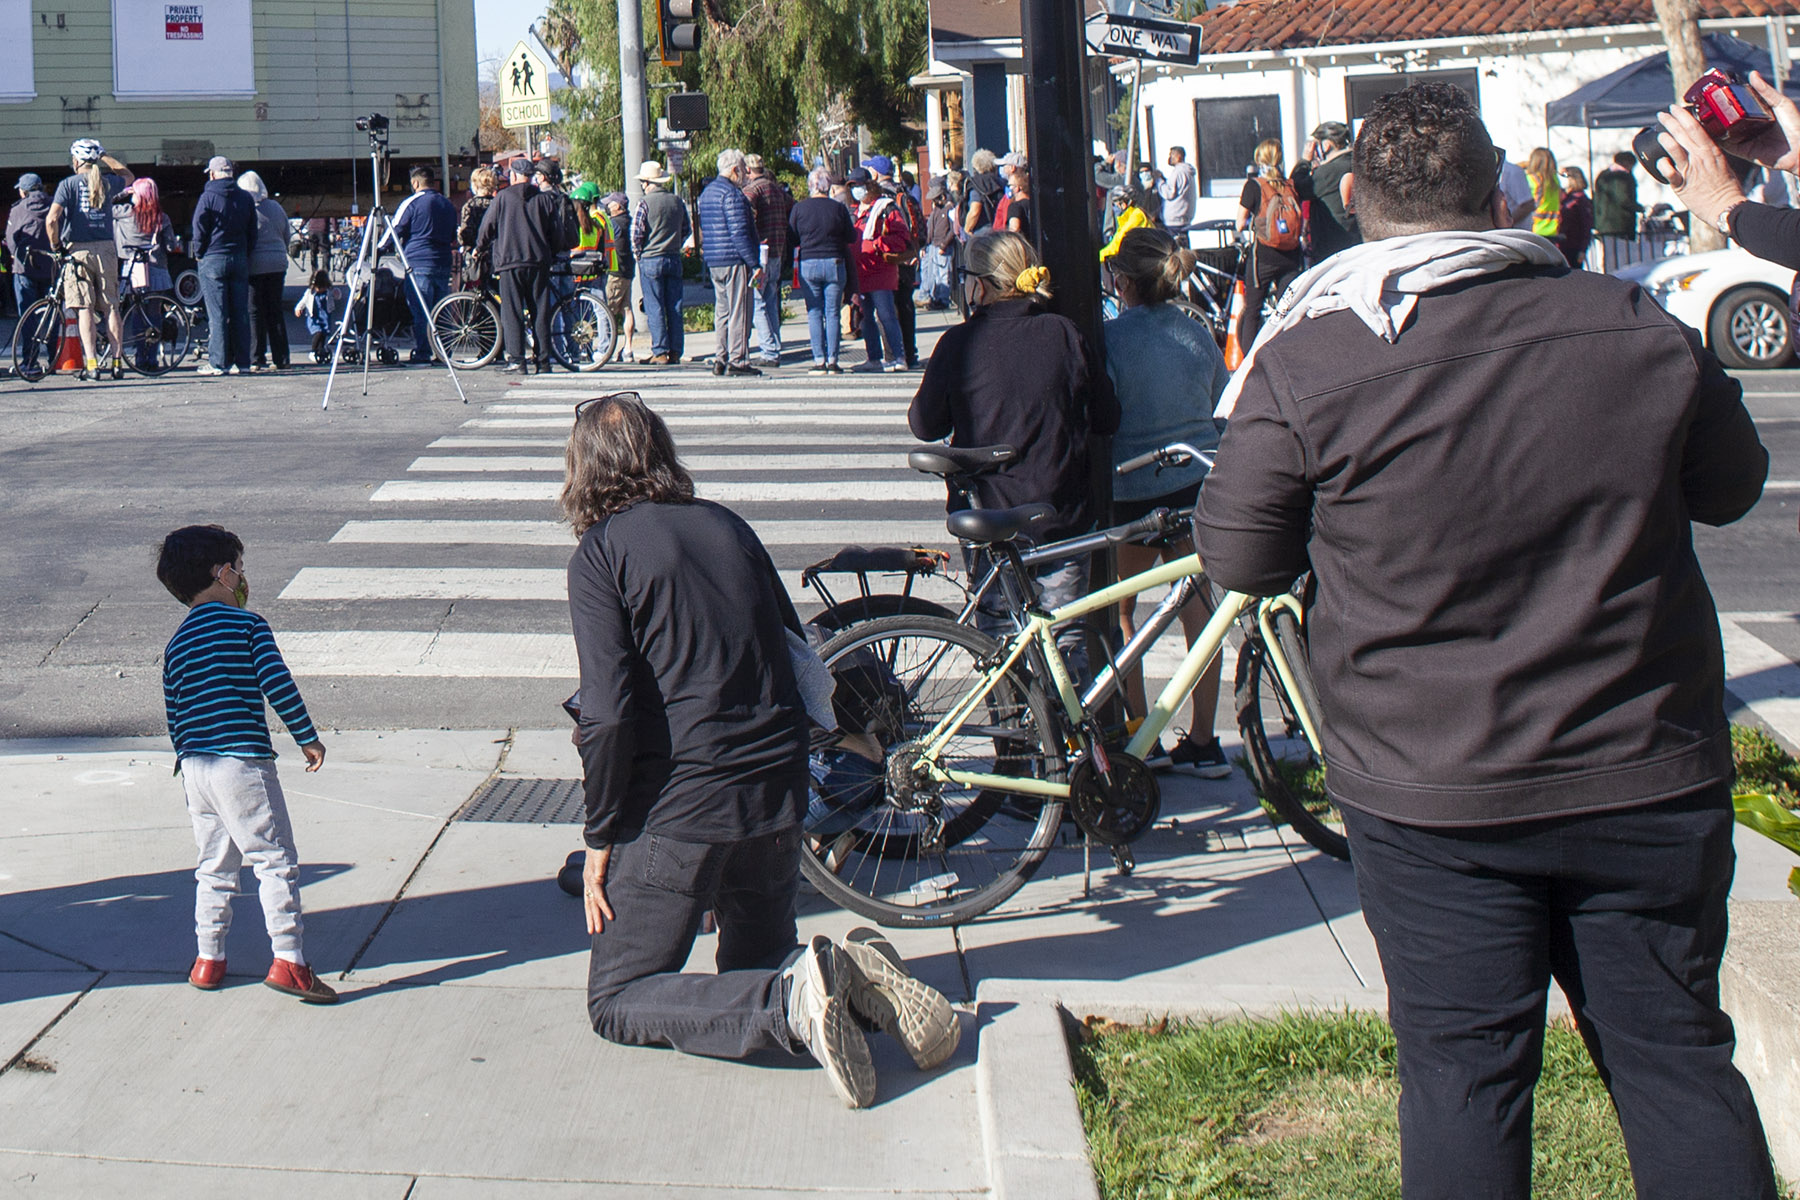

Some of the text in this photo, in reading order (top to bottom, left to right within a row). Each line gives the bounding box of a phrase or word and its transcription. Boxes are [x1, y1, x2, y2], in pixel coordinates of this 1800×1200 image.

[169, 5, 199, 14] PRIVATE
[166, 14, 203, 23] PROPERTY
[1110, 27, 1143, 46] ONE
[506, 103, 546, 121] SCHOOL
